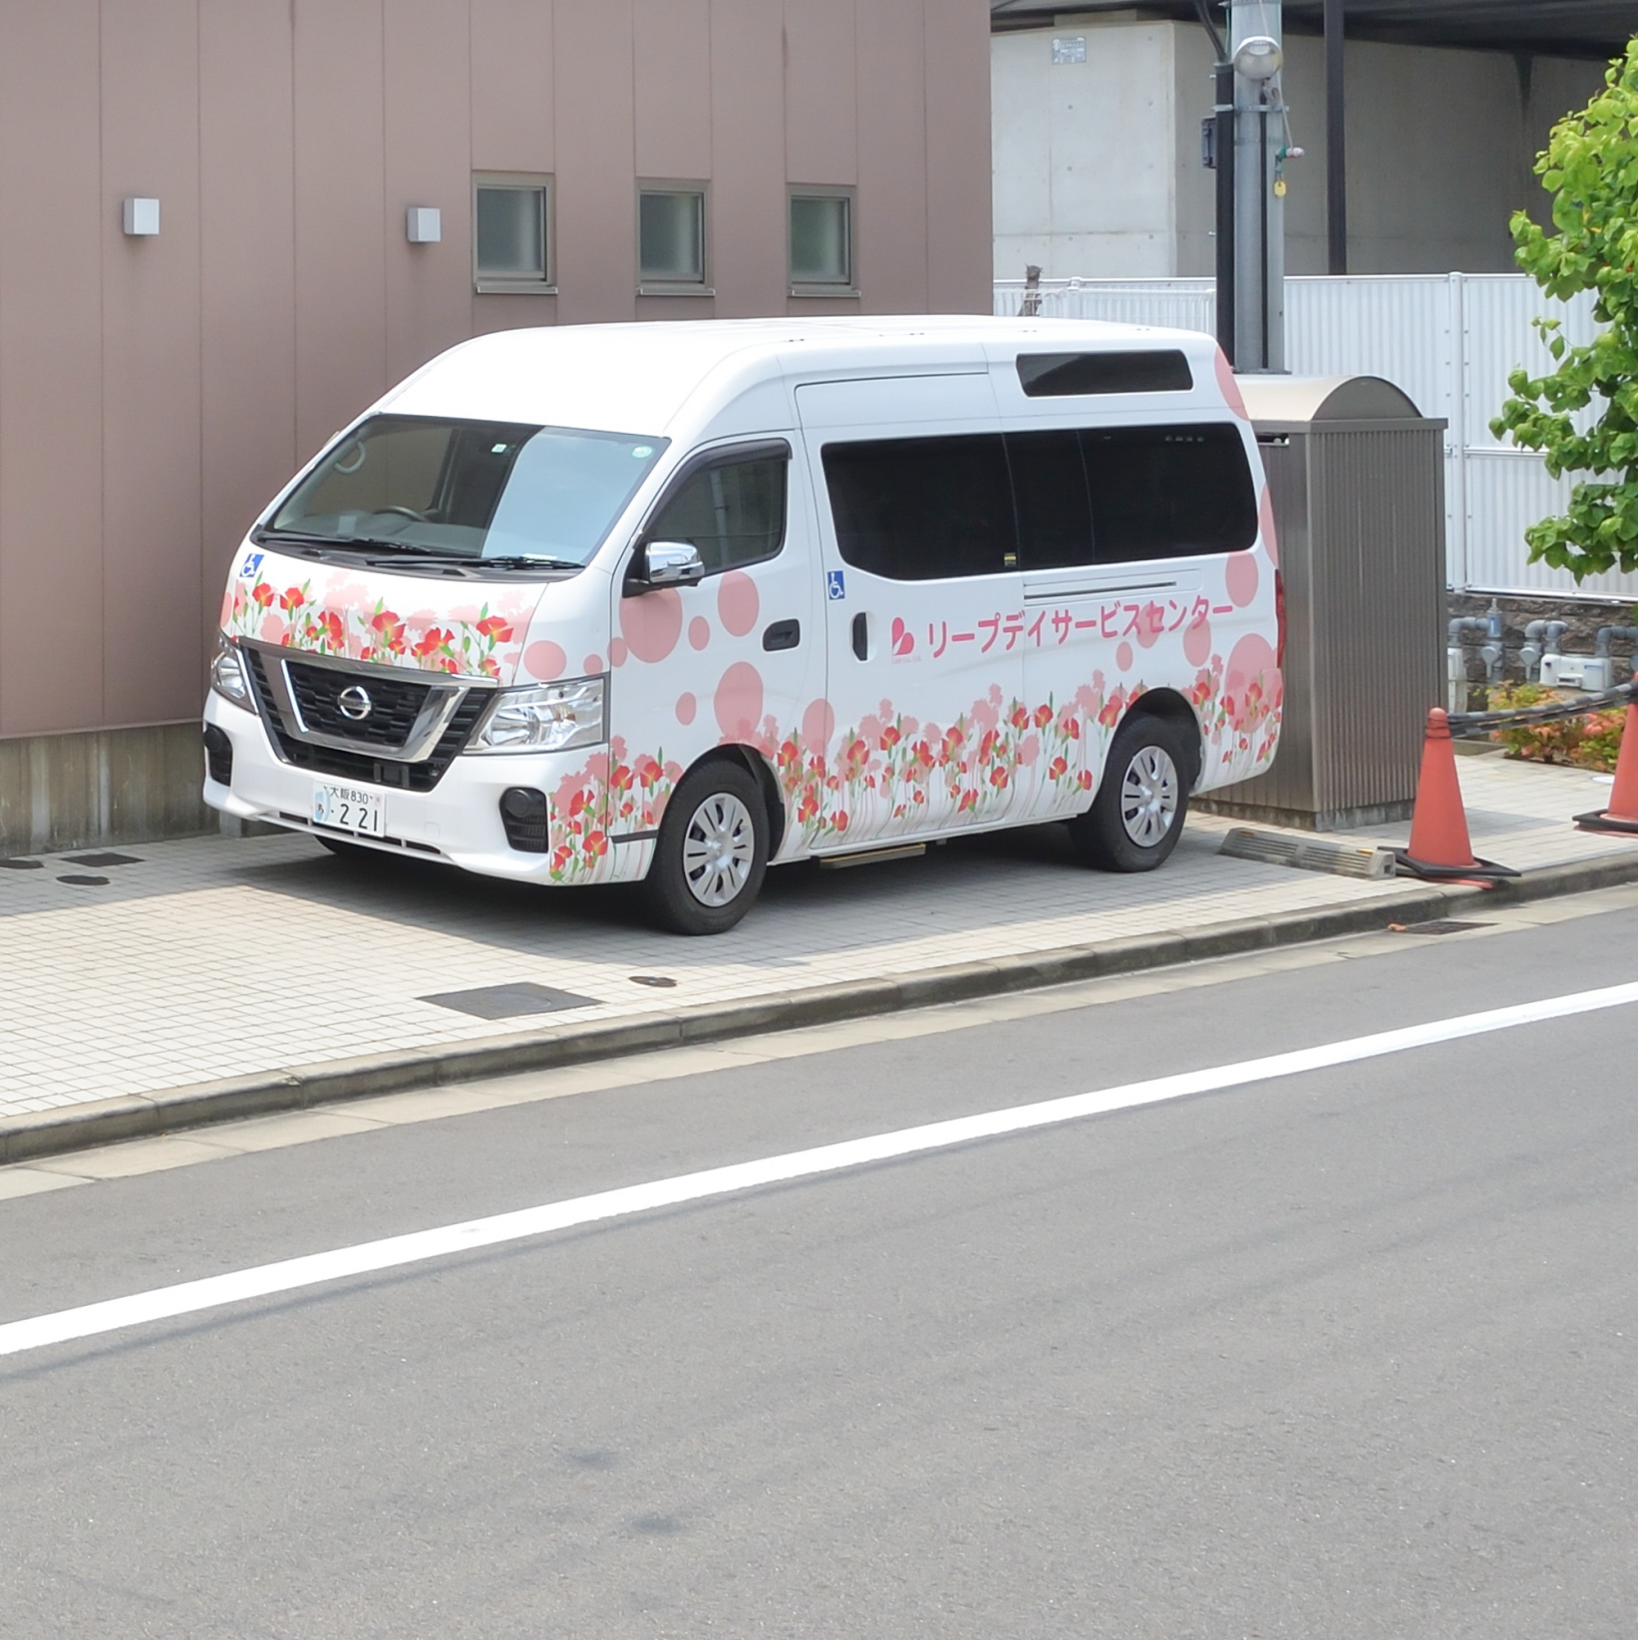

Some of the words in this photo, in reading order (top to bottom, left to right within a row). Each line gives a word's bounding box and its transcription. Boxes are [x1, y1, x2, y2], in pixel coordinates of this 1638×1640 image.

[928, 594, 1234, 659] リープデイサービスセンター
